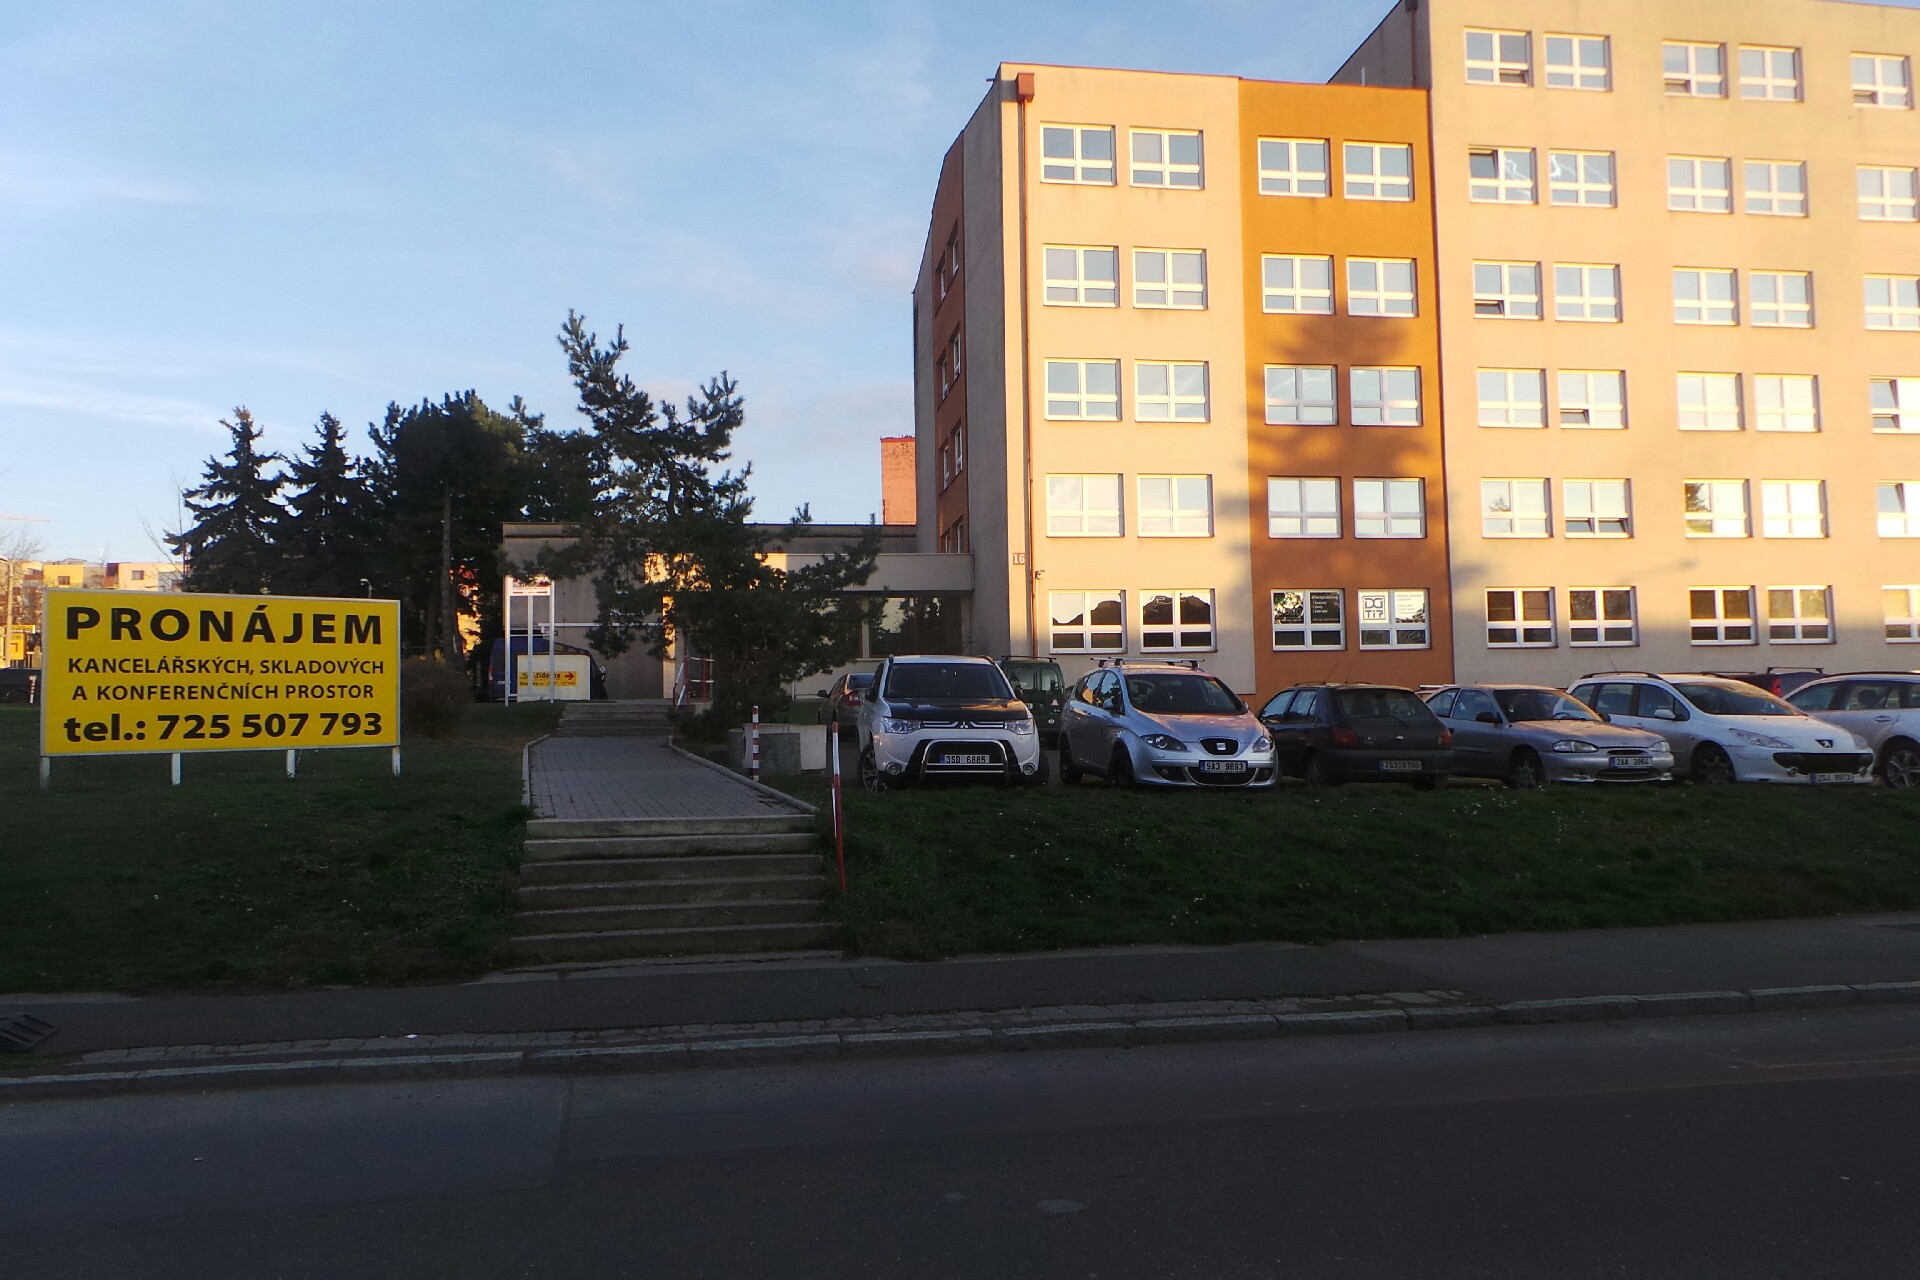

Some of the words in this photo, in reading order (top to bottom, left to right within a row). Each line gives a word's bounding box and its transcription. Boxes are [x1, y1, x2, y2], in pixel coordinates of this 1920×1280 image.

[1013, 553, 1026, 564] 16
[66, 604, 382, 645] PRONÁJEM
[68, 655, 254, 676] KANCELÁŘSKÝCH,
[260, 658, 384, 675] SKLADOVÝCH
[72, 686, 87, 701] A
[97, 683, 279, 701] KONFERENČNÍCH
[285, 685, 374, 700] PROSTOR
[63, 713, 146, 742] tel.:
[157, 714, 231, 740] 725
[241, 713, 309, 738] 507
[320, 712, 382, 737] 793
[946, 755, 961, 764] 3SD
[1206, 762, 1220, 770] 9A3
